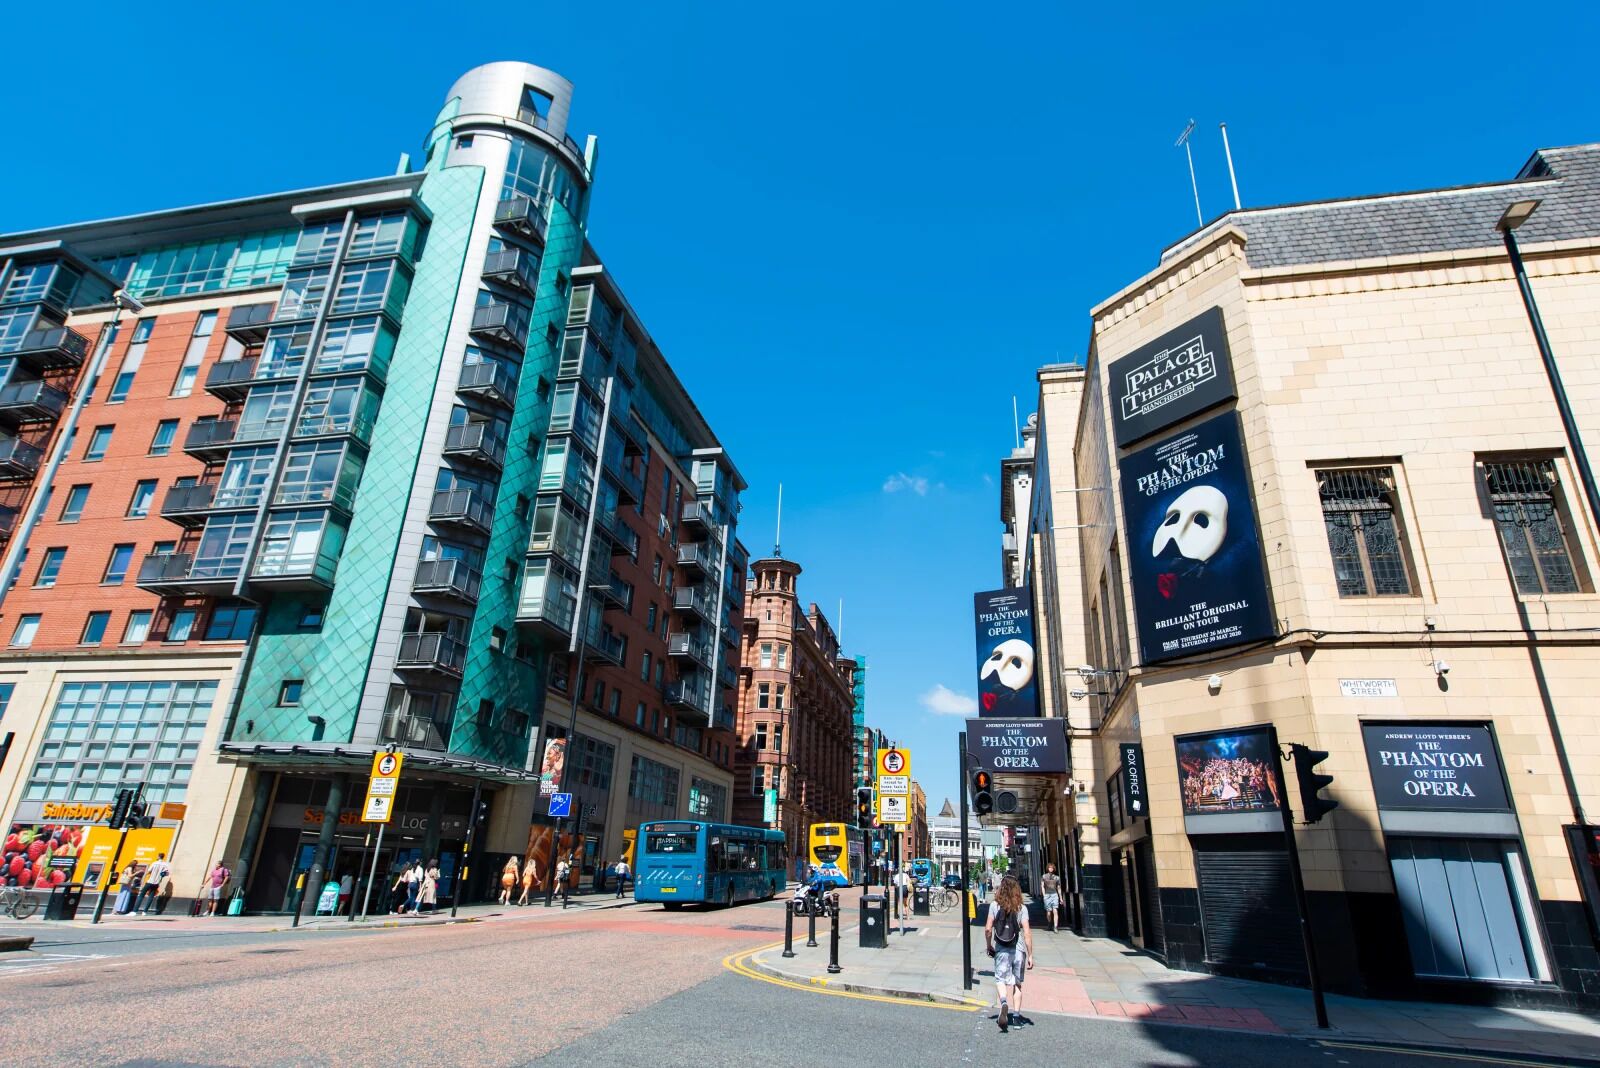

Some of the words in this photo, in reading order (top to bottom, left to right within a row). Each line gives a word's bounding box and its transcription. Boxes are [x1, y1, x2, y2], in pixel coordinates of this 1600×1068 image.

[1156, 352, 1168, 361] THE
[1129, 343, 1203, 393] PALACE
[1126, 358, 1212, 411] THEATRE
[1143, 385, 1193, 413] MANCHESTER
[1167, 451, 1189, 466] THE
[1137, 443, 1226, 492] PHANTOM
[1146, 485, 1159, 496] OF
[1160, 477, 1182, 490] THE
[1182, 463, 1219, 482] OPERA
[980, 609, 1028, 622] PHANTOM
[1155, 611, 1200, 629] BRILLIANT
[1202, 600, 1249, 617] ORIGINAL
[1190, 602, 1207, 612] THE
[988, 626, 1022, 636] OPERA
[1183, 621, 1195, 630] ON
[1196, 616, 1219, 627] TOUR
[1180, 633, 1209, 643] THURSDAY
[1216, 625, 1238, 635] MARCH
[1181, 638, 1209, 648] SATURDAY
[1216, 633, 1229, 641] MAY
[1229, 630, 1242, 638] 2020
[1341, 680, 1395, 688] WHITWORTH
[981, 736, 1048, 747] PHANTOM
[1416, 741, 1441, 750] THE
[993, 756, 1040, 768] OPERA
[1127, 749, 1136, 766] BOX
[1379, 751, 1485, 768] PHANTOM
[1129, 767, 1140, 795] OFFICE
[1414, 769, 1429, 778] OF
[1431, 769, 1457, 779] THE
[1403, 780, 1476, 797] OPERA
[42, 802, 113, 823] Sainsbury's
